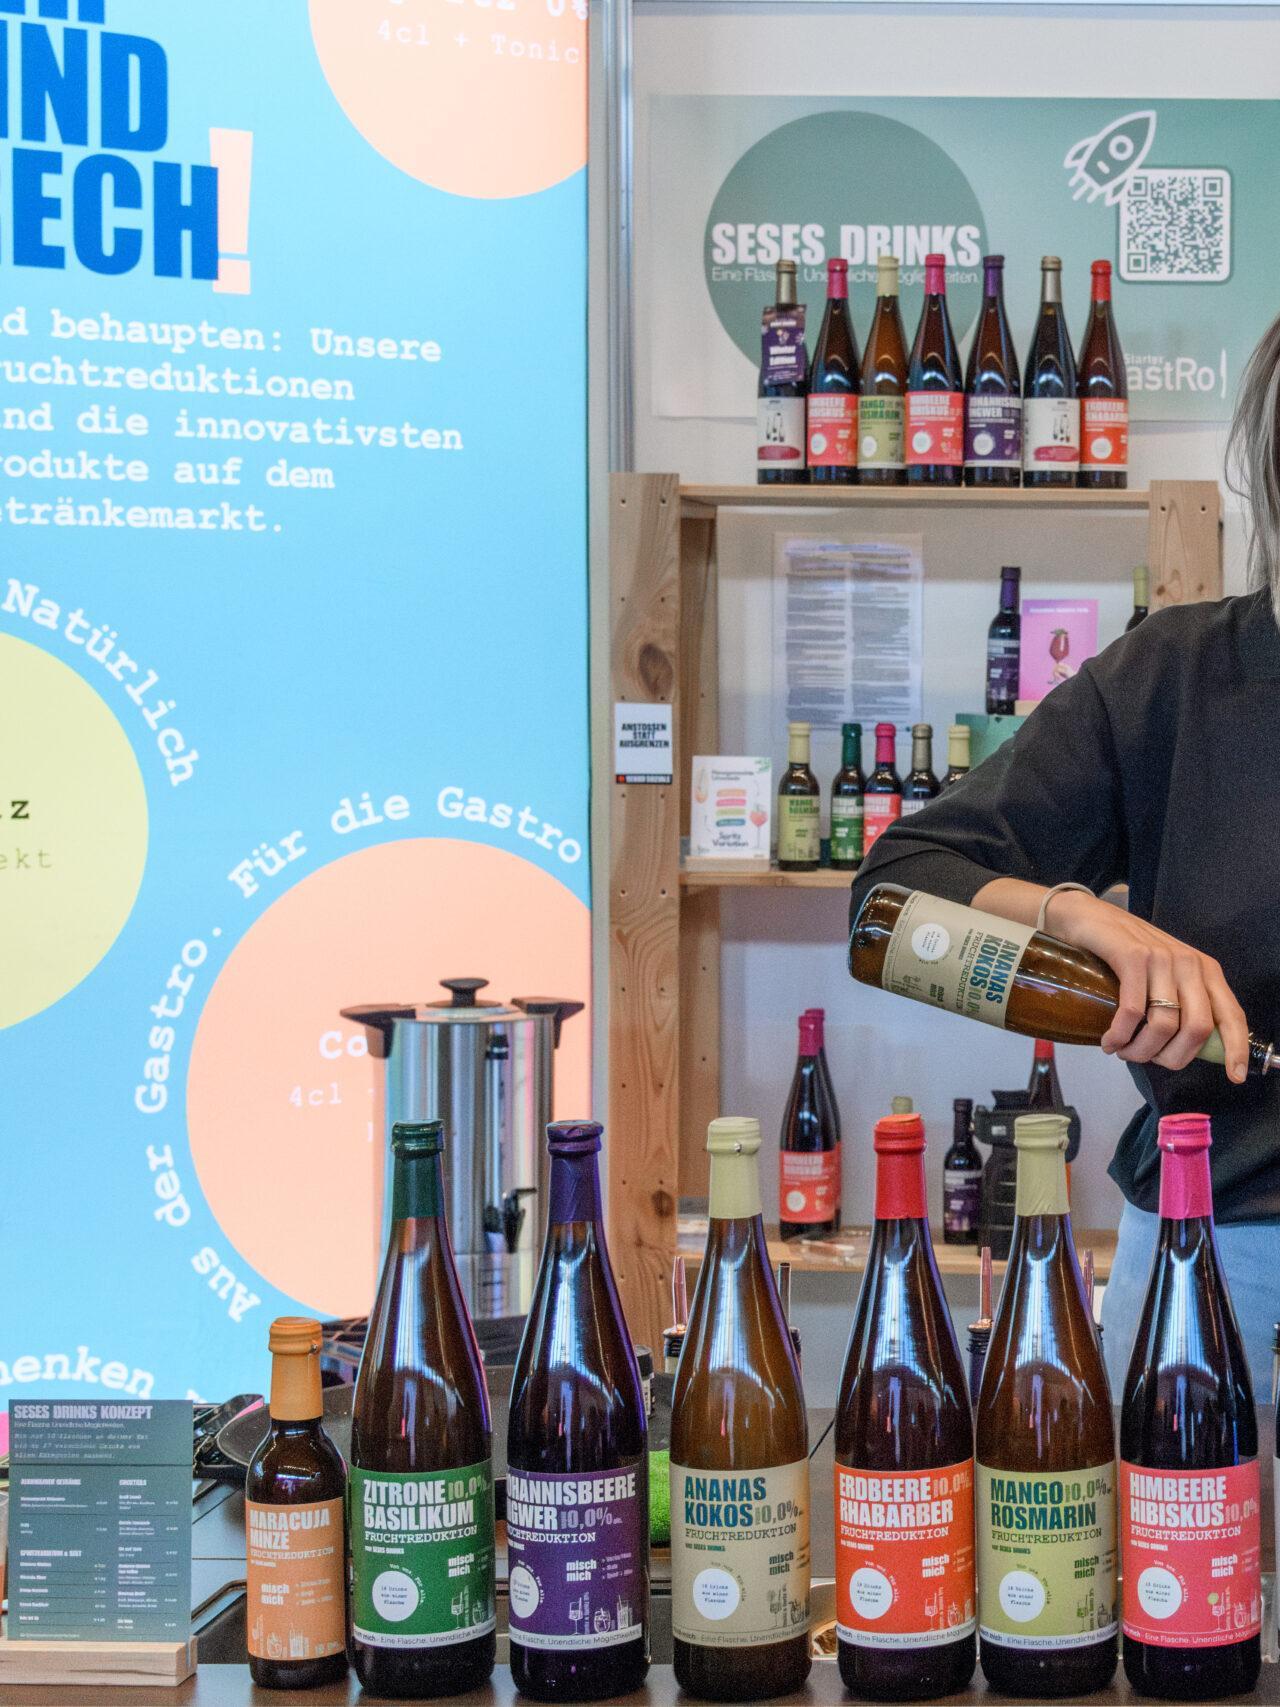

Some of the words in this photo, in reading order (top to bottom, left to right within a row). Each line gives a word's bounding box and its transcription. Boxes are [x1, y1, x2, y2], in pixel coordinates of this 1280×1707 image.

[377, 19, 430, 46] 4cl
[490, 32, 580, 64] Tonic
[0, 127, 253, 293] ECH!
[711, 222, 825, 265] SESES
[840, 224, 981, 267] DRINKS
[711, 268, 742, 282] Eine
[51, 308, 284, 354] behaupten:
[310, 327, 442, 363] Unsere
[0, 355, 355, 401] uchtreduktionen
[1126, 356, 1216, 392] astRo
[0, 402, 55, 432] nd
[76, 404, 150, 436] die
[174, 408, 464, 451] innovativsten
[0, 449, 150, 482] odukte
[174, 457, 244, 487] auf
[265, 458, 335, 490] dem
[0, 496, 283, 533] tränkemarkt.
[2, 578, 200, 787] Natürlich
[228, 829, 308, 899] Für
[330, 792, 411, 836] die
[436, 786, 583, 865] Gastro
[969, 934, 1004, 989] KOKOS
[985, 939, 1021, 1004] ANANAS
[319, 1030, 369, 1059] Co
[288, 1081, 343, 1107] 4cl
[146, 1142, 192, 1228] der
[191, 1246, 262, 1324] Aus
[14, 1404, 50, 1419] SESES
[53, 1404, 97, 1419] DRINKS
[100, 1404, 153, 1419] KONZEPT
[363, 1479, 446, 1505] ZITRONE
[684, 1475, 767, 1502] ANANAS
[839, 1472, 931, 1502] ERDBEERE
[991, 1477, 1064, 1505] MANGO
[1130, 1472, 1227, 1502] HIMBEERE
[363, 1500, 474, 1531] BASILIKUM
[685, 1501, 753, 1528] KOKOS
[840, 1499, 954, 1528] RHABARBER
[991, 1501, 1097, 1531] ROSMARIN
[1130, 1497, 1224, 1528] HIBISKUS
[250, 1528, 290, 1550] MINZE
[364, 1525, 477, 1544] FRUCHTREDUKTION
[685, 1523, 797, 1542] FRUCHTREDUKTION
[840, 1524, 950, 1541] FRUCHTREDUKTION
[991, 1527, 1103, 1544] FRUCHTREDUKTION
[1131, 1524, 1241, 1541] FRUCHTREDUKTION
[448, 1552, 475, 1567] misch
[448, 1564, 471, 1578] mich
[566, 1559, 597, 1572] misch
[768, 1550, 794, 1565] misch
[769, 1563, 791, 1576] mich
[922, 1553, 950, 1567] misch
[1074, 1555, 1100, 1569] misch
[1212, 1553, 1238, 1567] misch
[566, 1570, 592, 1582] mich
[922, 1565, 945, 1578] mich
[1074, 1566, 1096, 1580] mich
[1212, 1565, 1234, 1578] mich
